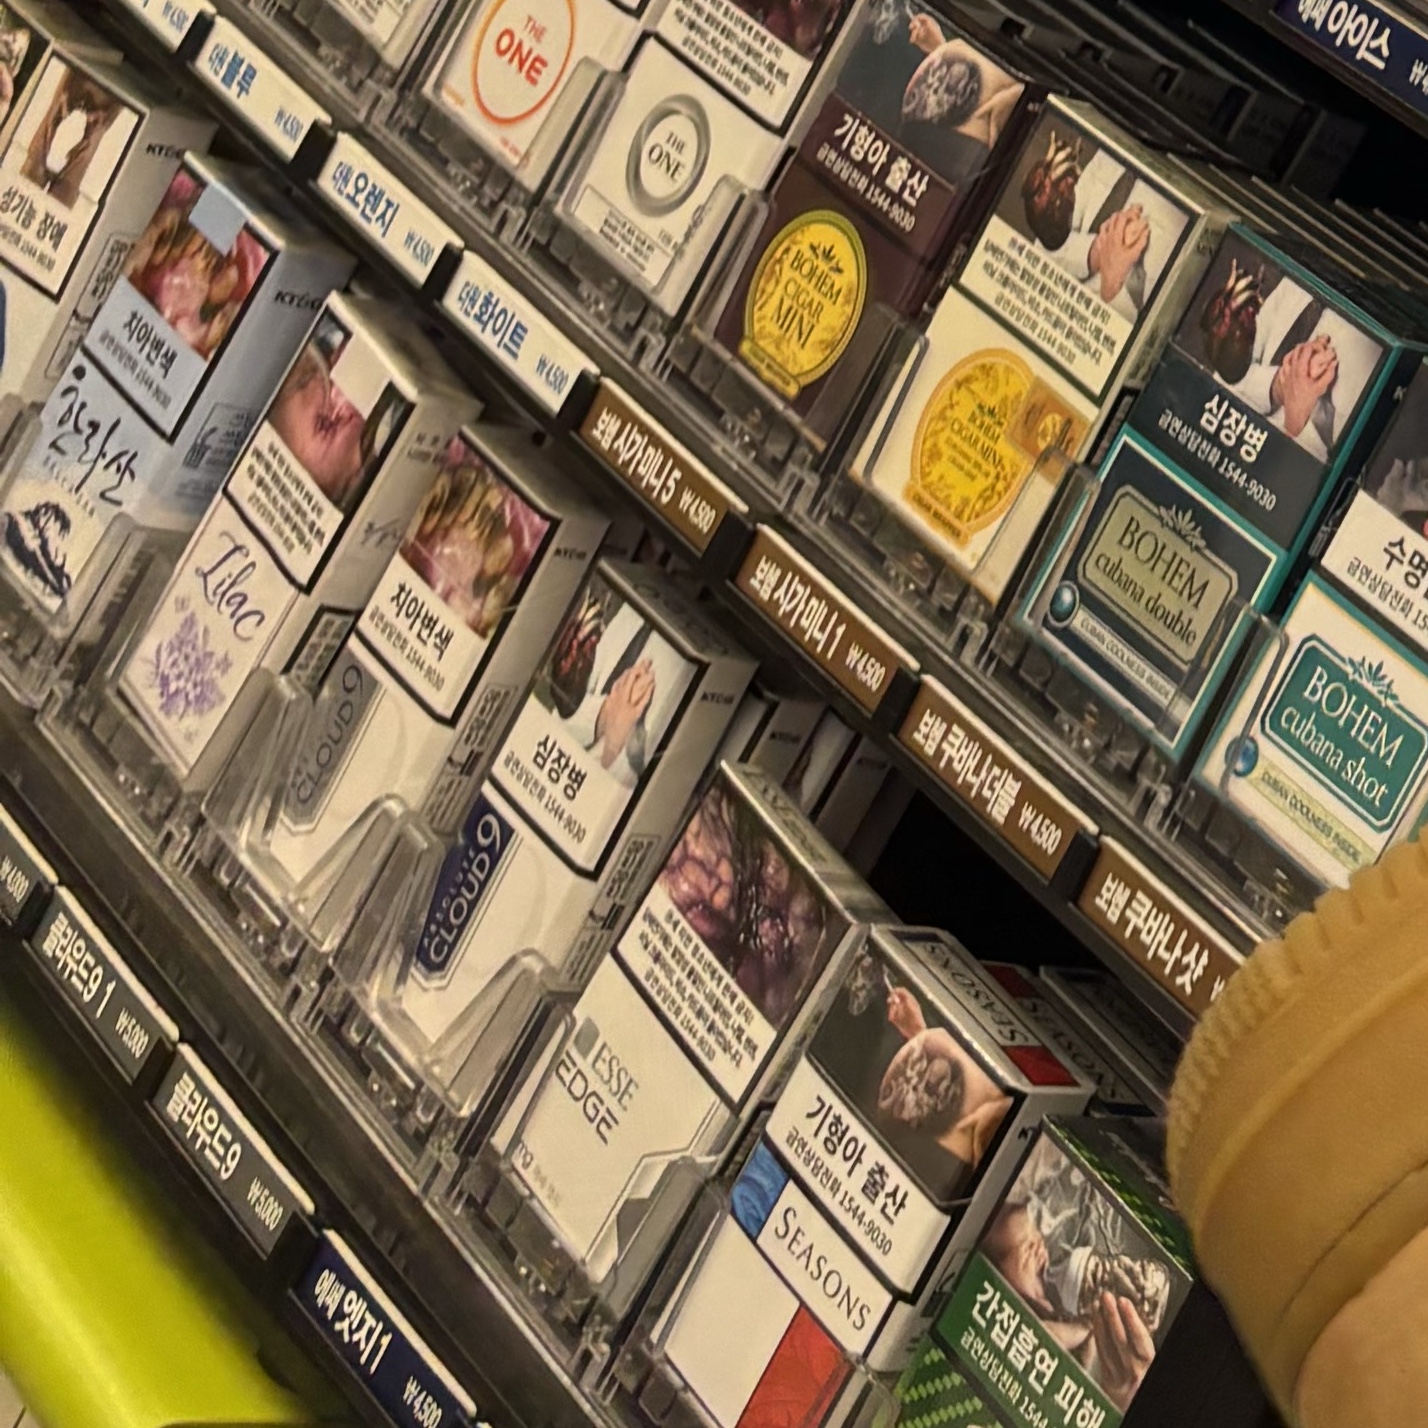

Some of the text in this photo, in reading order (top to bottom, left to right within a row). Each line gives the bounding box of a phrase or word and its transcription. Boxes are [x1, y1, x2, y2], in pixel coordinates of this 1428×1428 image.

[494, 26, 551, 89] ONE
[1201, 392, 1270, 458] 심장병
[196, 535, 270, 645] Lilac
[389, 580, 454, 657] 치아변색
[1279, 709, 1391, 809] cubana shot
[1302, 663, 1406, 771] BOHEM
[804, 1094, 912, 1227] 기형아 출산
[772, 1204, 875, 1335] SEASONS
